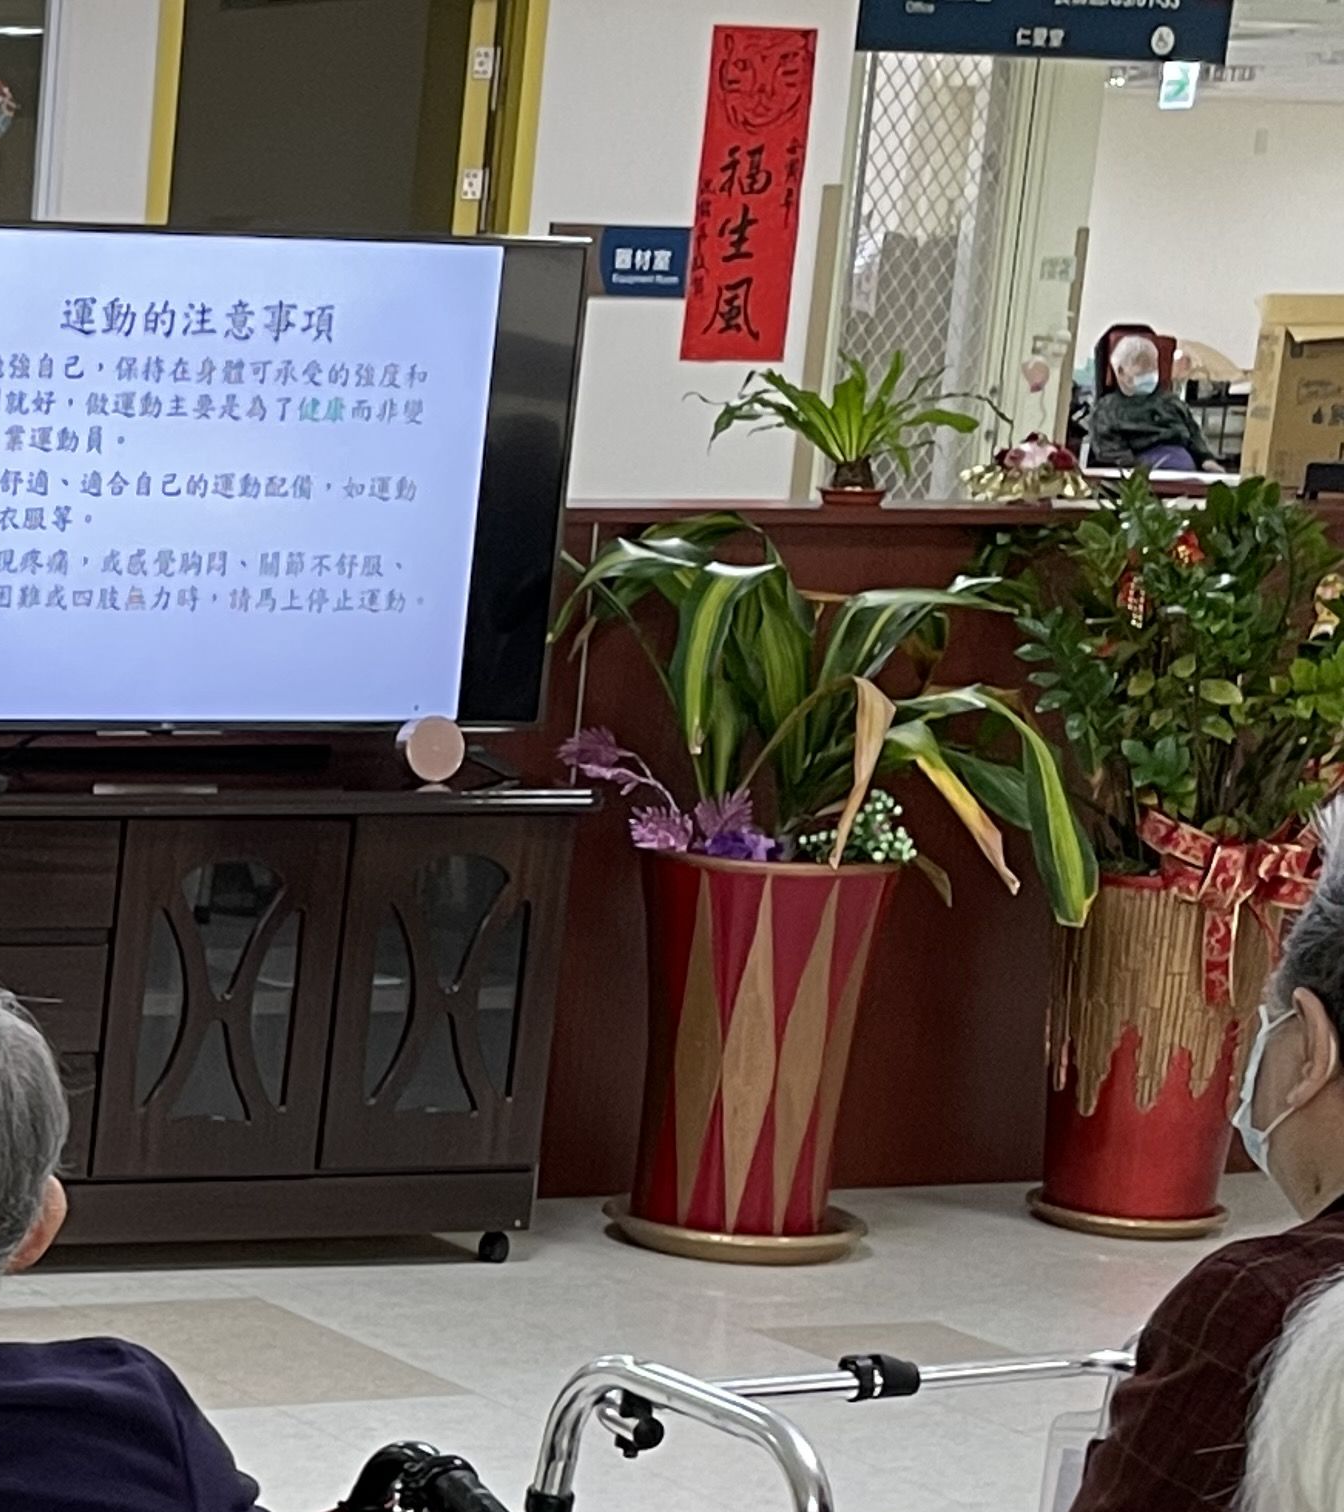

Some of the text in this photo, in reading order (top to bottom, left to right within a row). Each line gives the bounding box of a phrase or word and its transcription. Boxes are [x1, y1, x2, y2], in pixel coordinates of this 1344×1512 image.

[615, 247, 672, 271] 器材室
[702, 143, 772, 342] 福生風
[59, 296, 336, 343] 運動的注意事項
